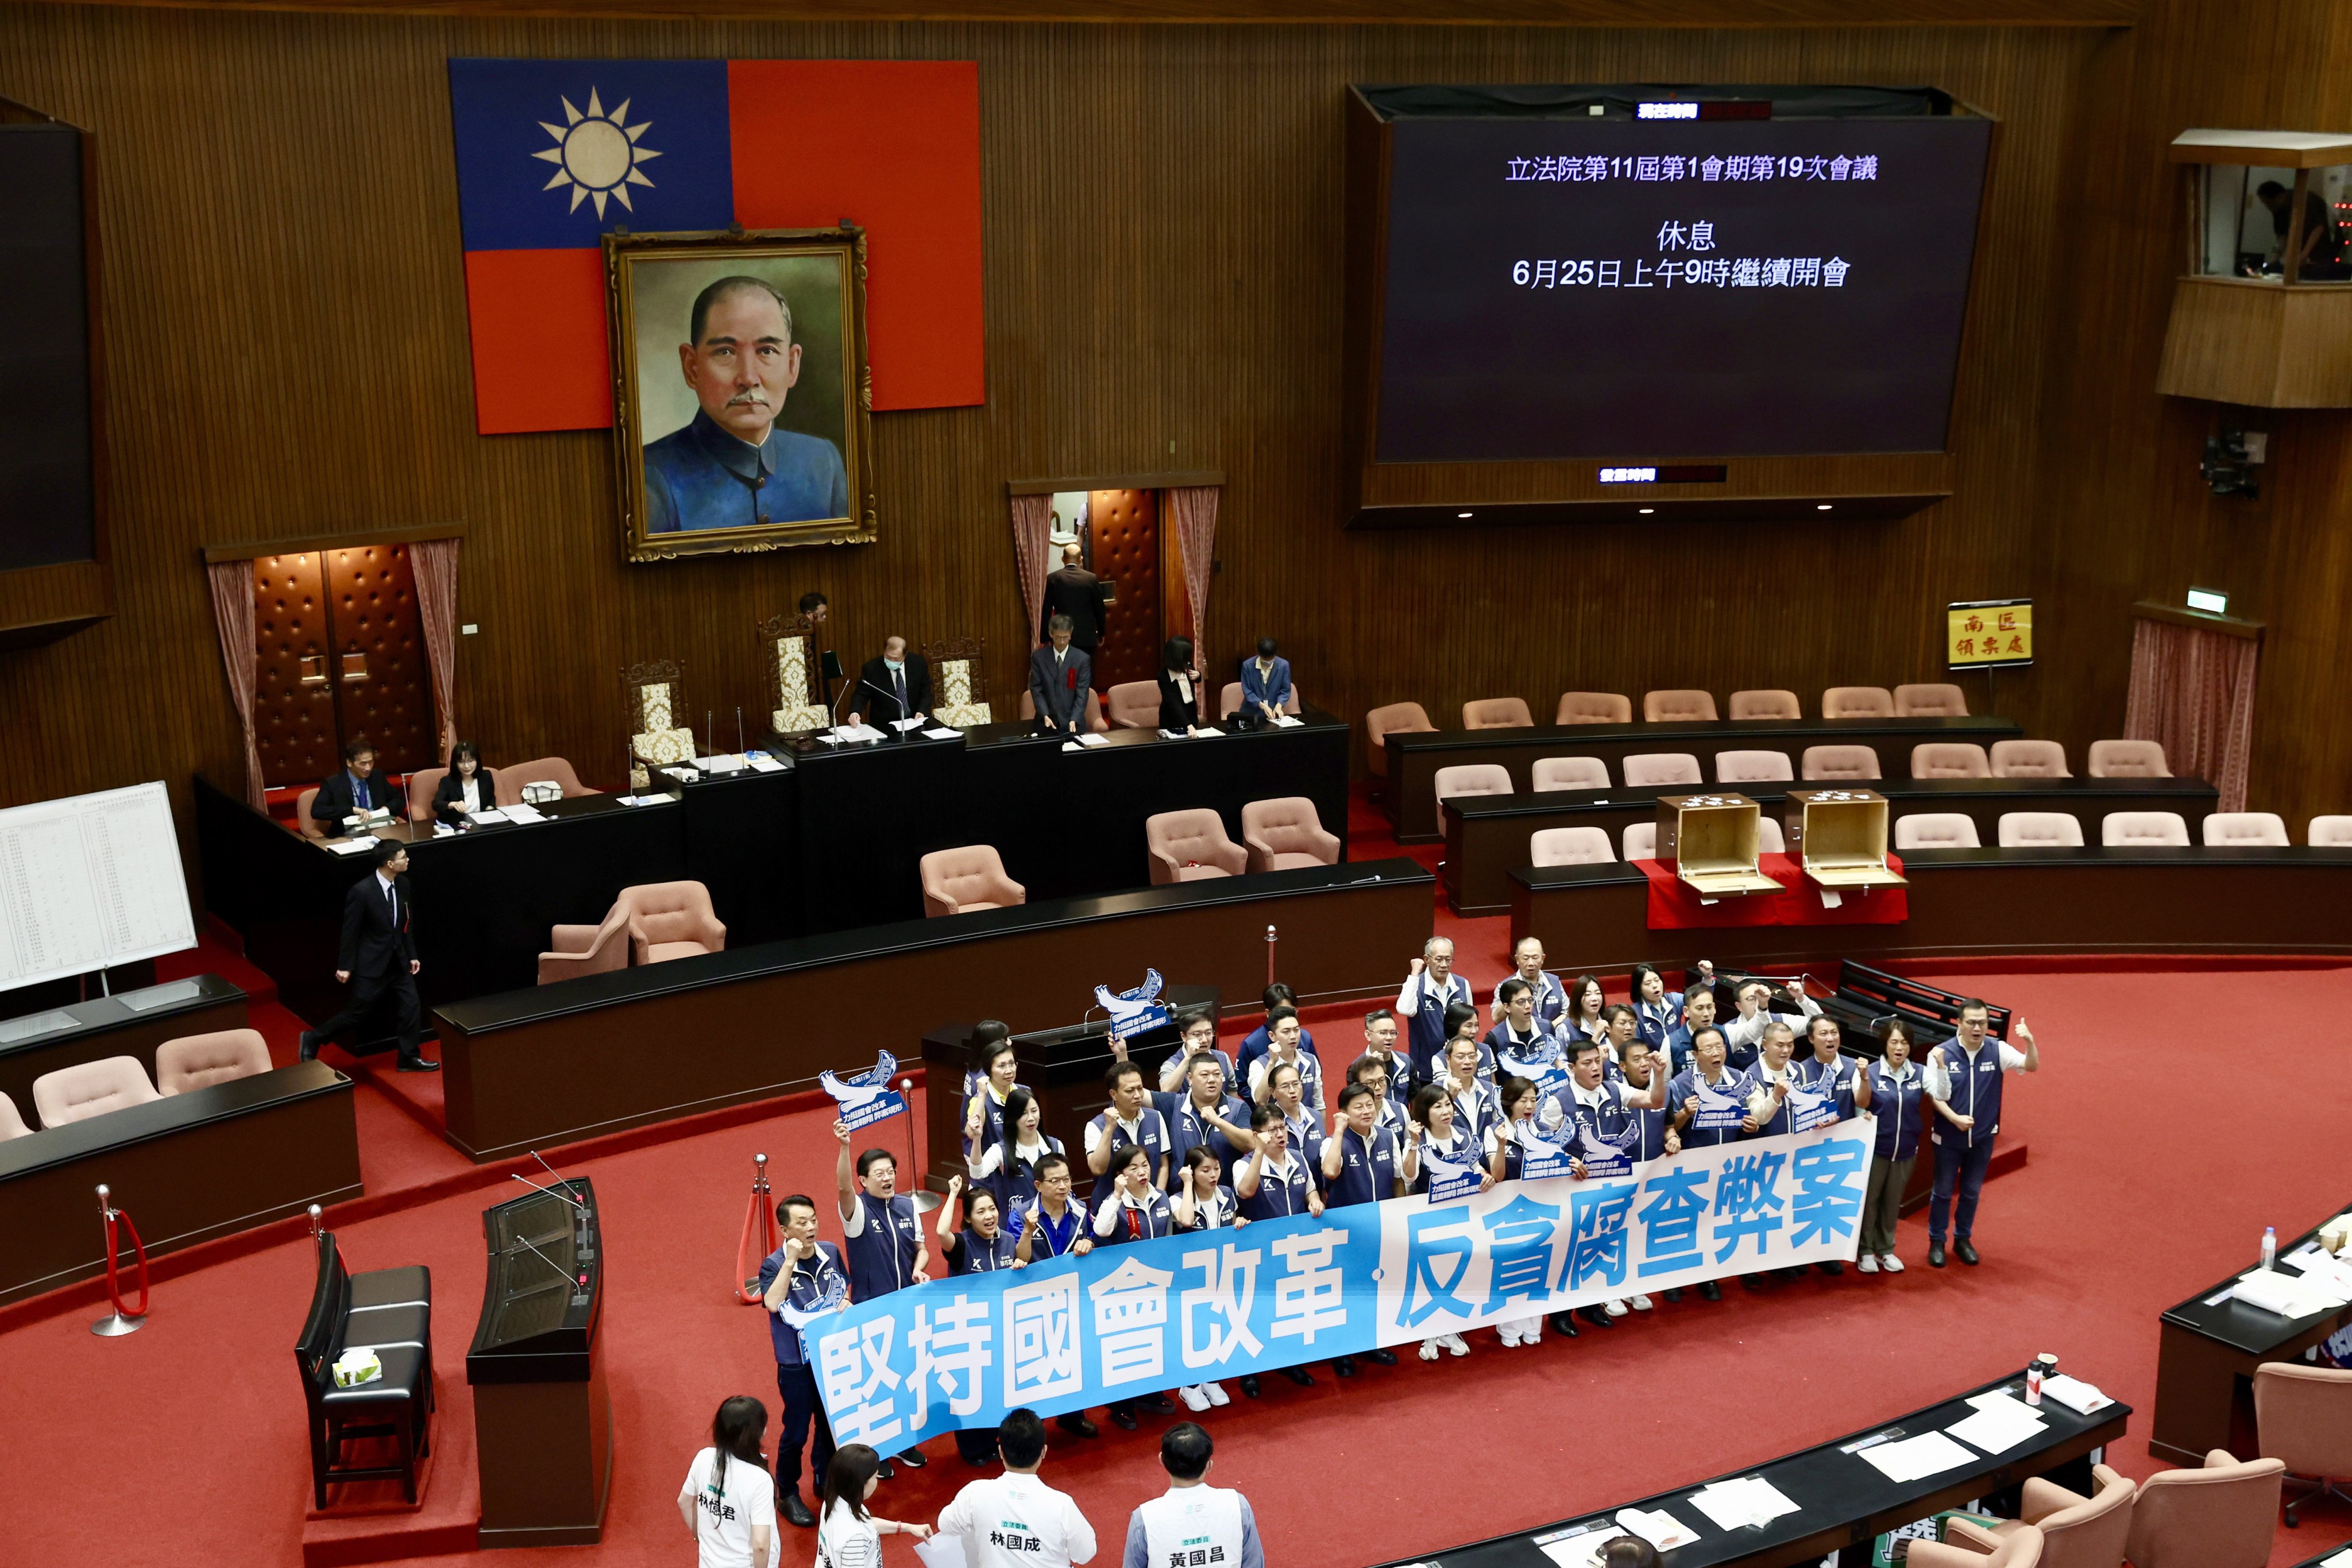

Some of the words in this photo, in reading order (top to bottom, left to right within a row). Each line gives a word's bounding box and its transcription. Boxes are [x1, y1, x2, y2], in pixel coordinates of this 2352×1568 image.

[1505, 155, 1878, 182] 立法院第11屆第1會期第19次會議
[1657, 220, 1715, 252] 休息
[1513, 256, 1851, 289] 6月25日上午9時繼續開會
[1956, 635, 2024, 656] 領票處
[1114, 1013, 1153, 1033] 力挺國會改革
[843, 1099, 887, 1123] 力挺國會改革
[874, 1102, 903, 1121] 弊案現形
[1525, 1159, 1561, 1170] 力挺國會改革
[1432, 1178, 1470, 1194] 力挺國會改革
[698, 1492, 735, 1521] 林憶君
[1002, 1522, 1027, 1531] 立法委員
[990, 1531, 1041, 1552] 林國成
[1183, 1536, 1209, 1546] 立法委員
[1169, 1546, 1225, 1568] 黃國昌
